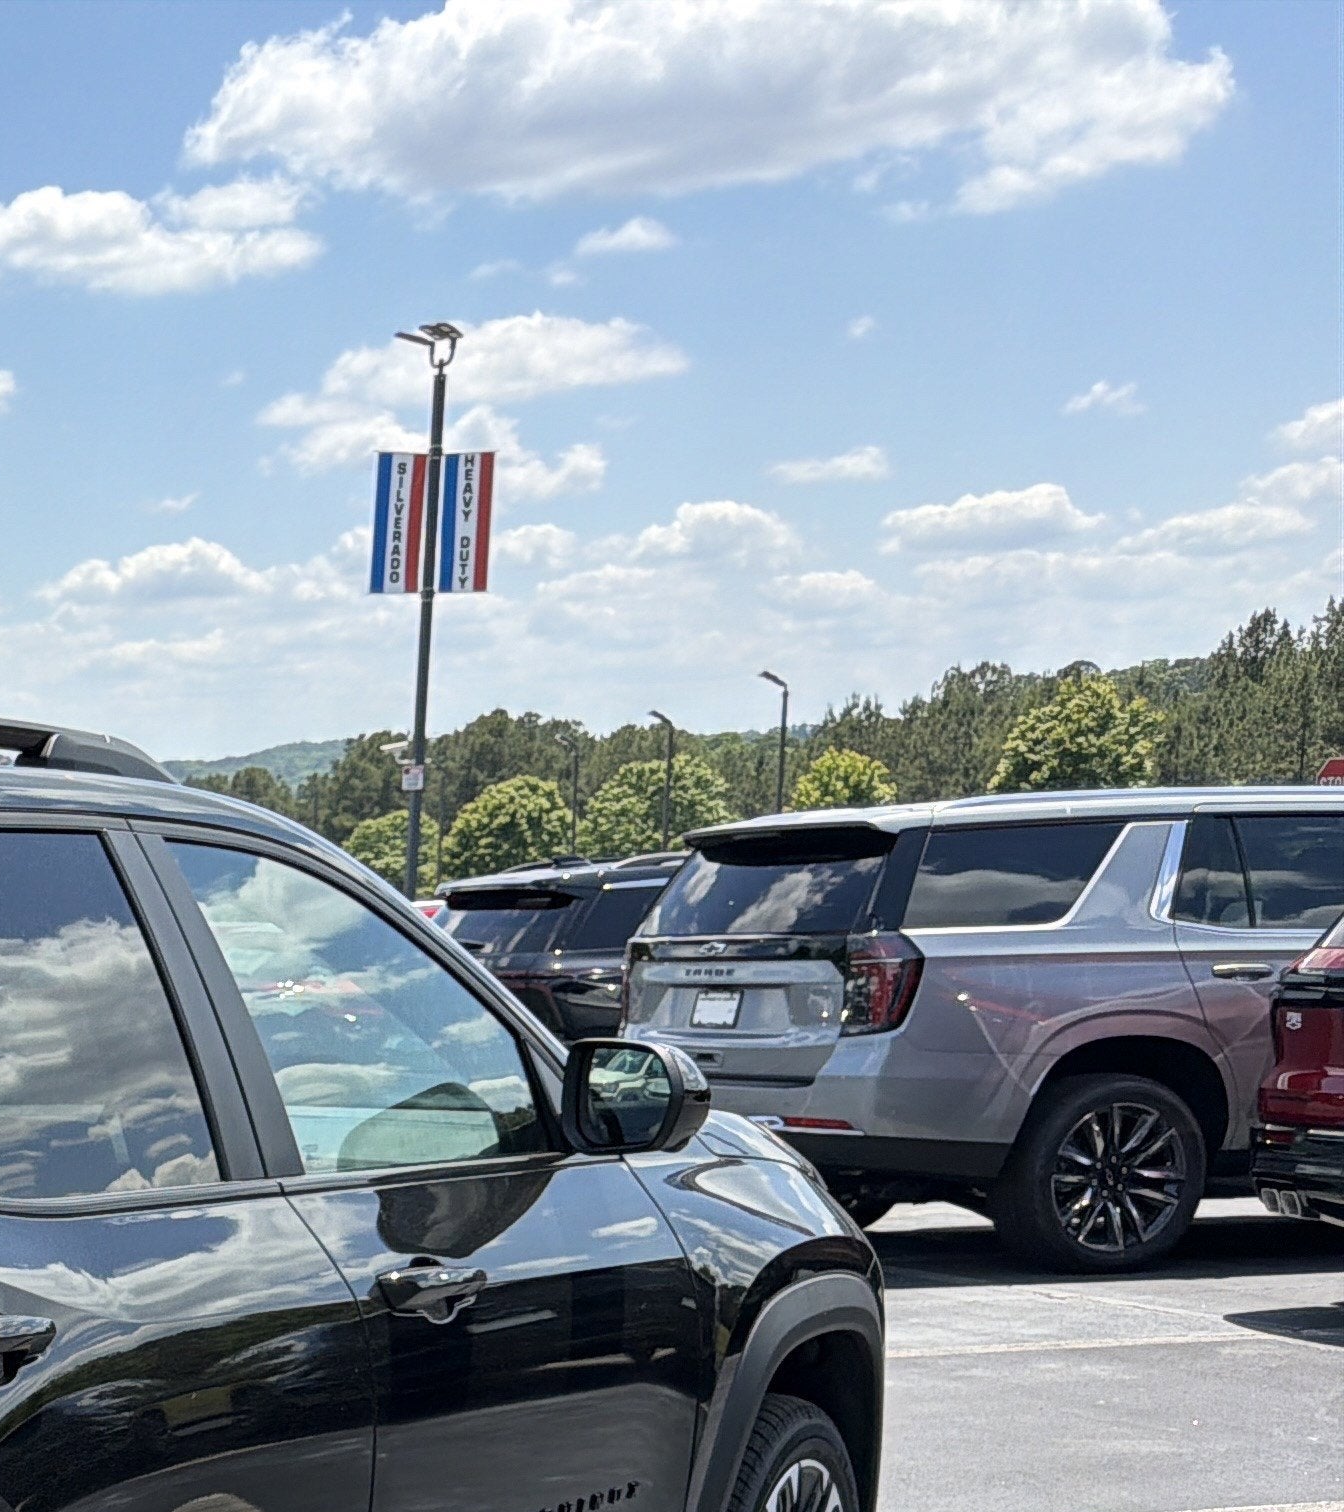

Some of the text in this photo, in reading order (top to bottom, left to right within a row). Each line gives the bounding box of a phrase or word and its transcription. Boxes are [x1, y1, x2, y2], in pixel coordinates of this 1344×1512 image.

[389, 462, 407, 583] SILVERADO
[459, 455, 475, 589] HEAVY DUTY
